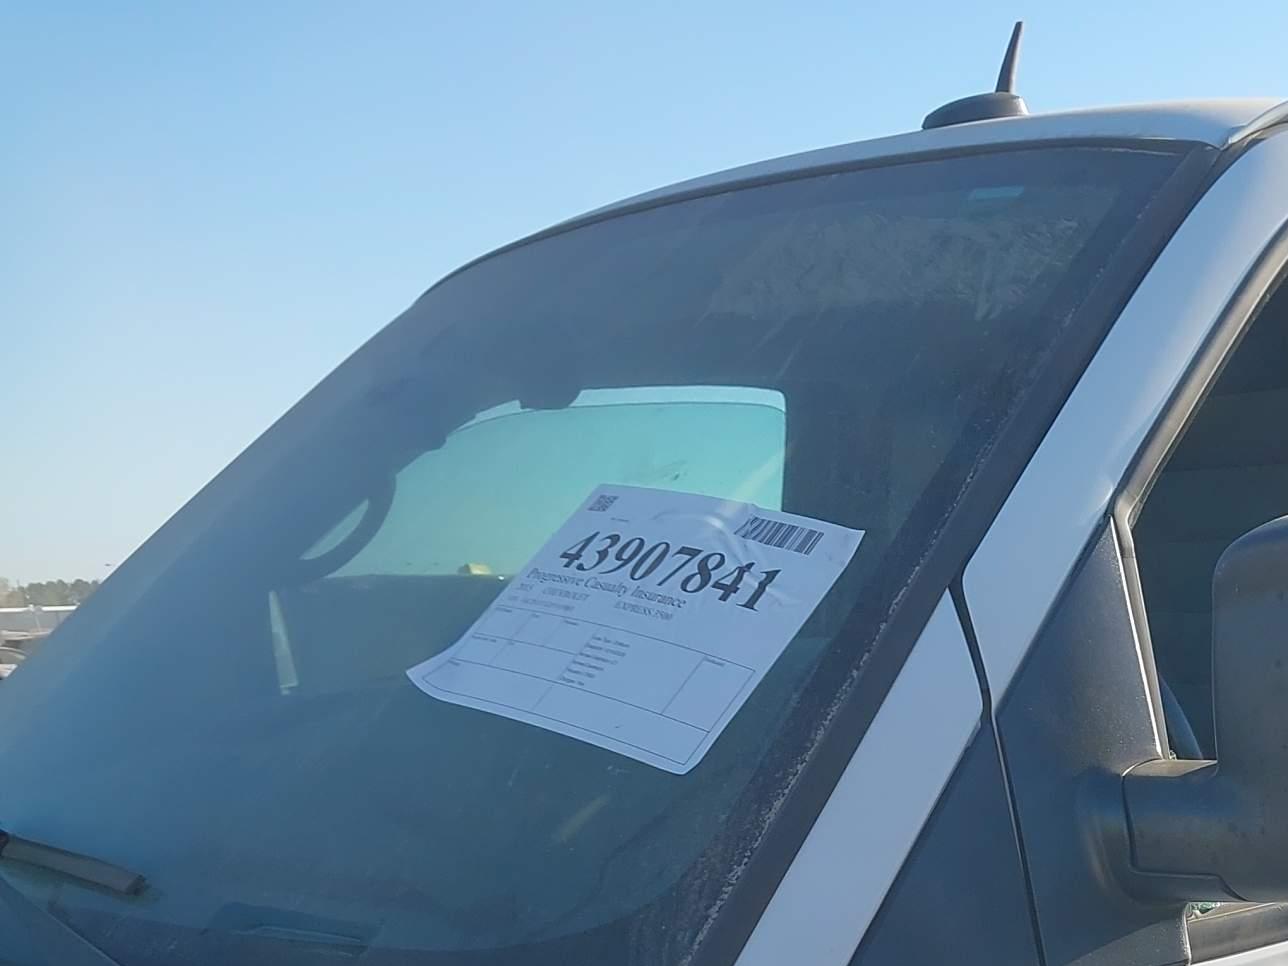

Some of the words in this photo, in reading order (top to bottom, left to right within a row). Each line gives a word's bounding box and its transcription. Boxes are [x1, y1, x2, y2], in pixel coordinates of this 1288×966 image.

[526, 567, 585, 586] Progressive
[583, 576, 627, 598] Casualty
[630, 585, 687, 608] Insurance
[559, 531, 782, 612] 43907841
